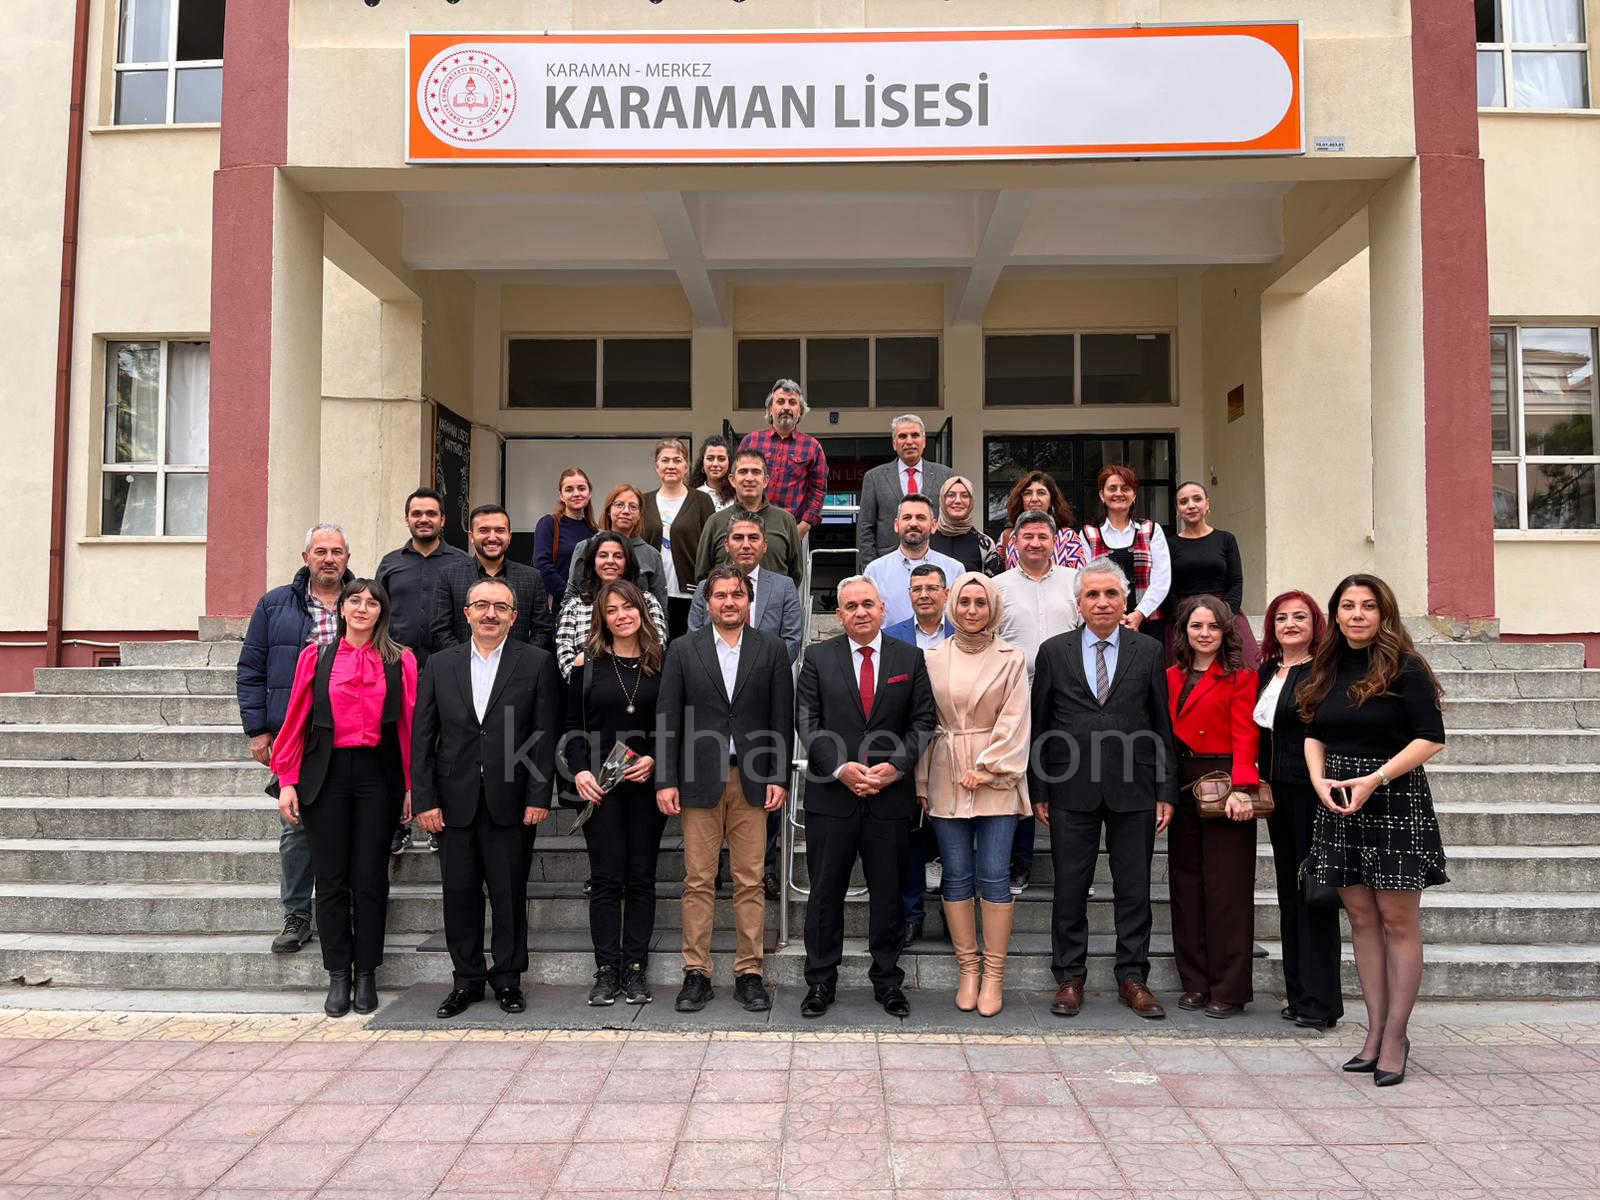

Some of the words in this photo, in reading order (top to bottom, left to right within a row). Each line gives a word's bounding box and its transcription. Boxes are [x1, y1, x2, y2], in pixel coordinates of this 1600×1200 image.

[546, 63, 630, 77] KARAMAN
[646, 63, 712, 77] MERKEZ
[546, 85, 815, 129] KARAMAN
[835, 72, 989, 128] LİSESİ
